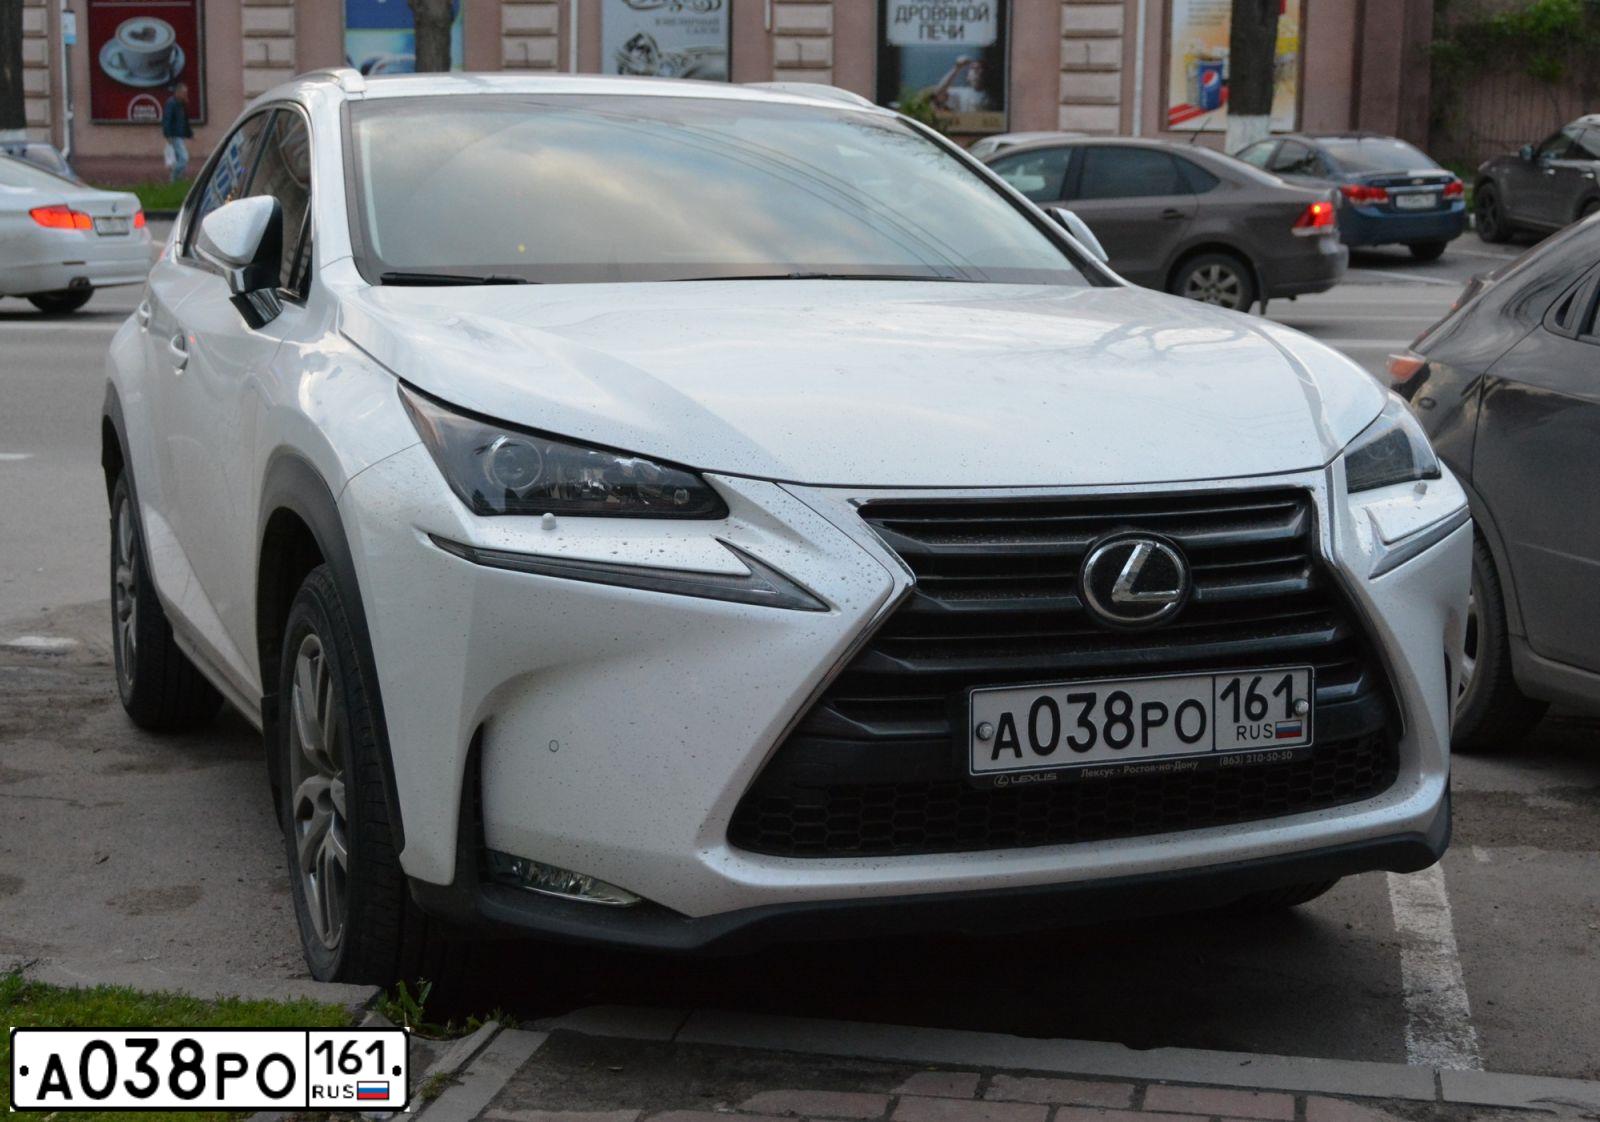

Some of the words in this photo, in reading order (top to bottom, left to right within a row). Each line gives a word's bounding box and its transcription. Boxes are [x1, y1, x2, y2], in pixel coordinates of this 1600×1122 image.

[895, 3, 990, 22] ДРОВЯНОЙ
[919, 23, 965, 40] ПЕЧИ
[1220, 674, 1294, 723] 161
[1236, 723, 1274, 741] RUS
[1011, 772, 1057, 785] LEXUS
